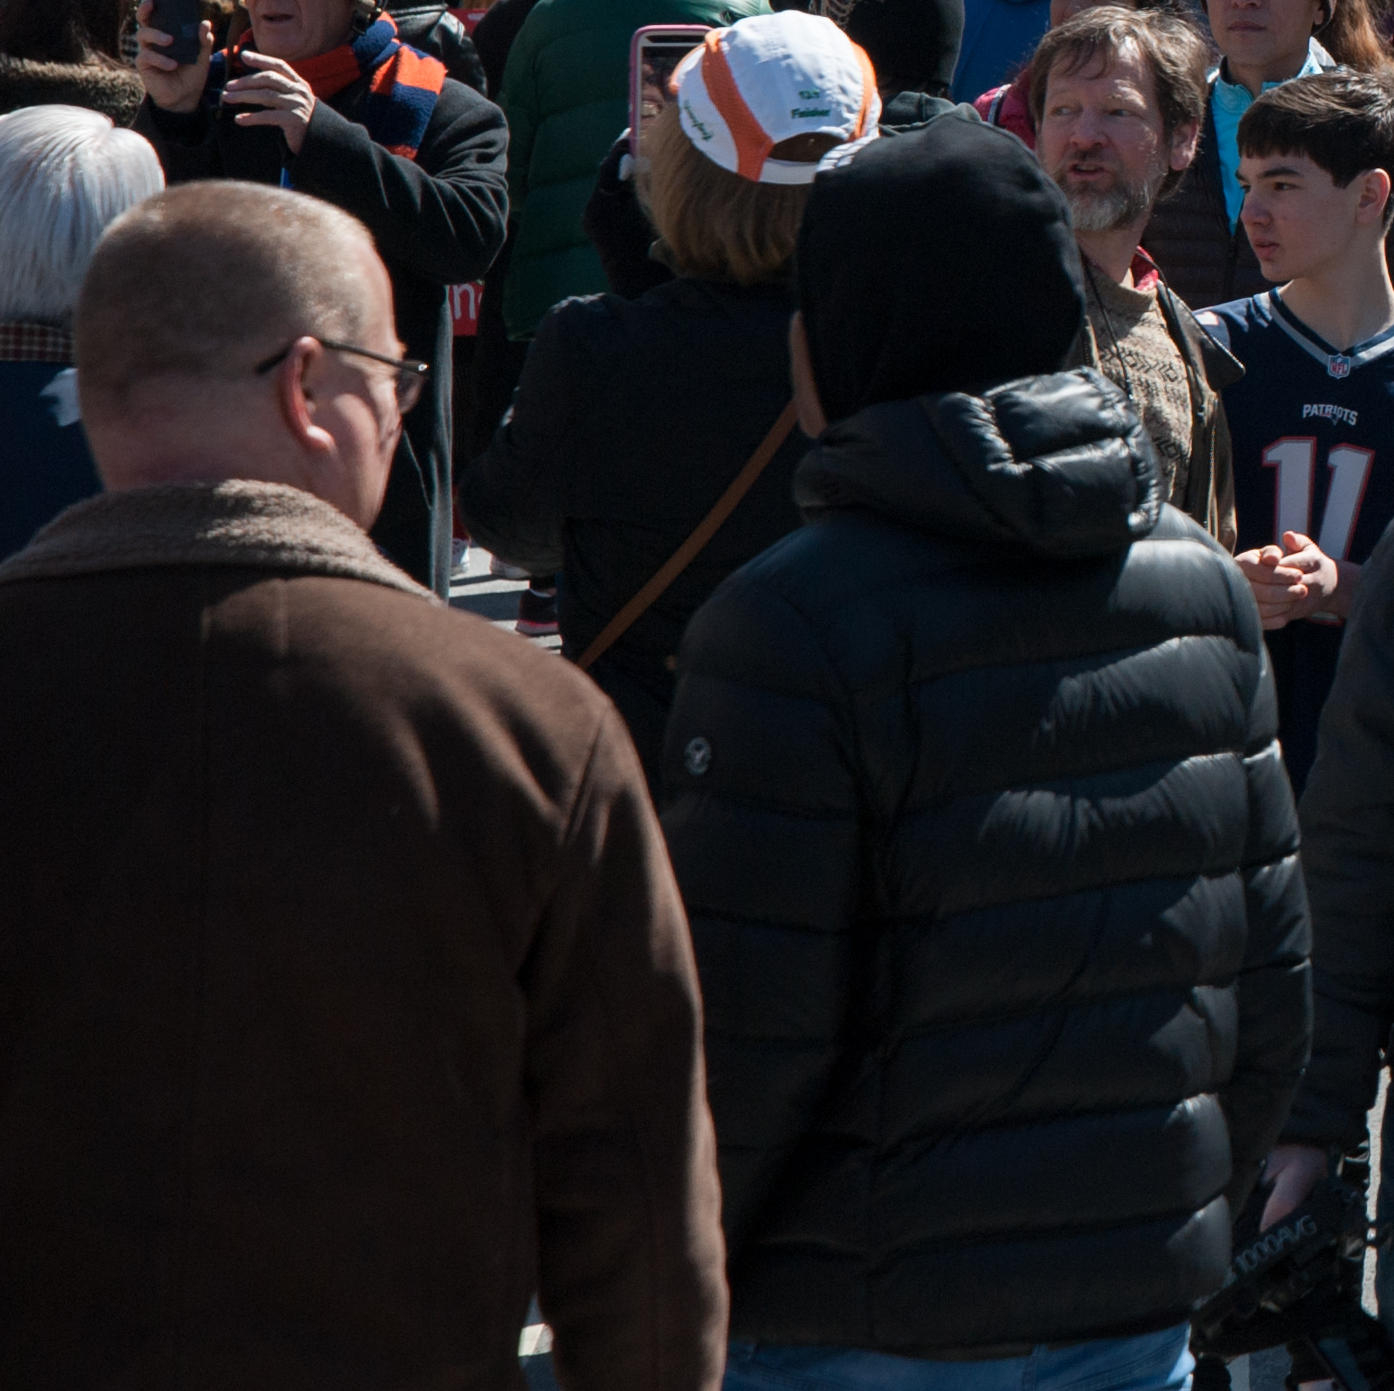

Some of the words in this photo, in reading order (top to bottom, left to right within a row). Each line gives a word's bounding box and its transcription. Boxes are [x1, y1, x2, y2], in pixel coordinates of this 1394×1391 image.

[1331, 361, 1348, 376] NFL
[1302, 402, 1359, 426] PATRIOTS
[1261, 436, 1376, 561] 11
